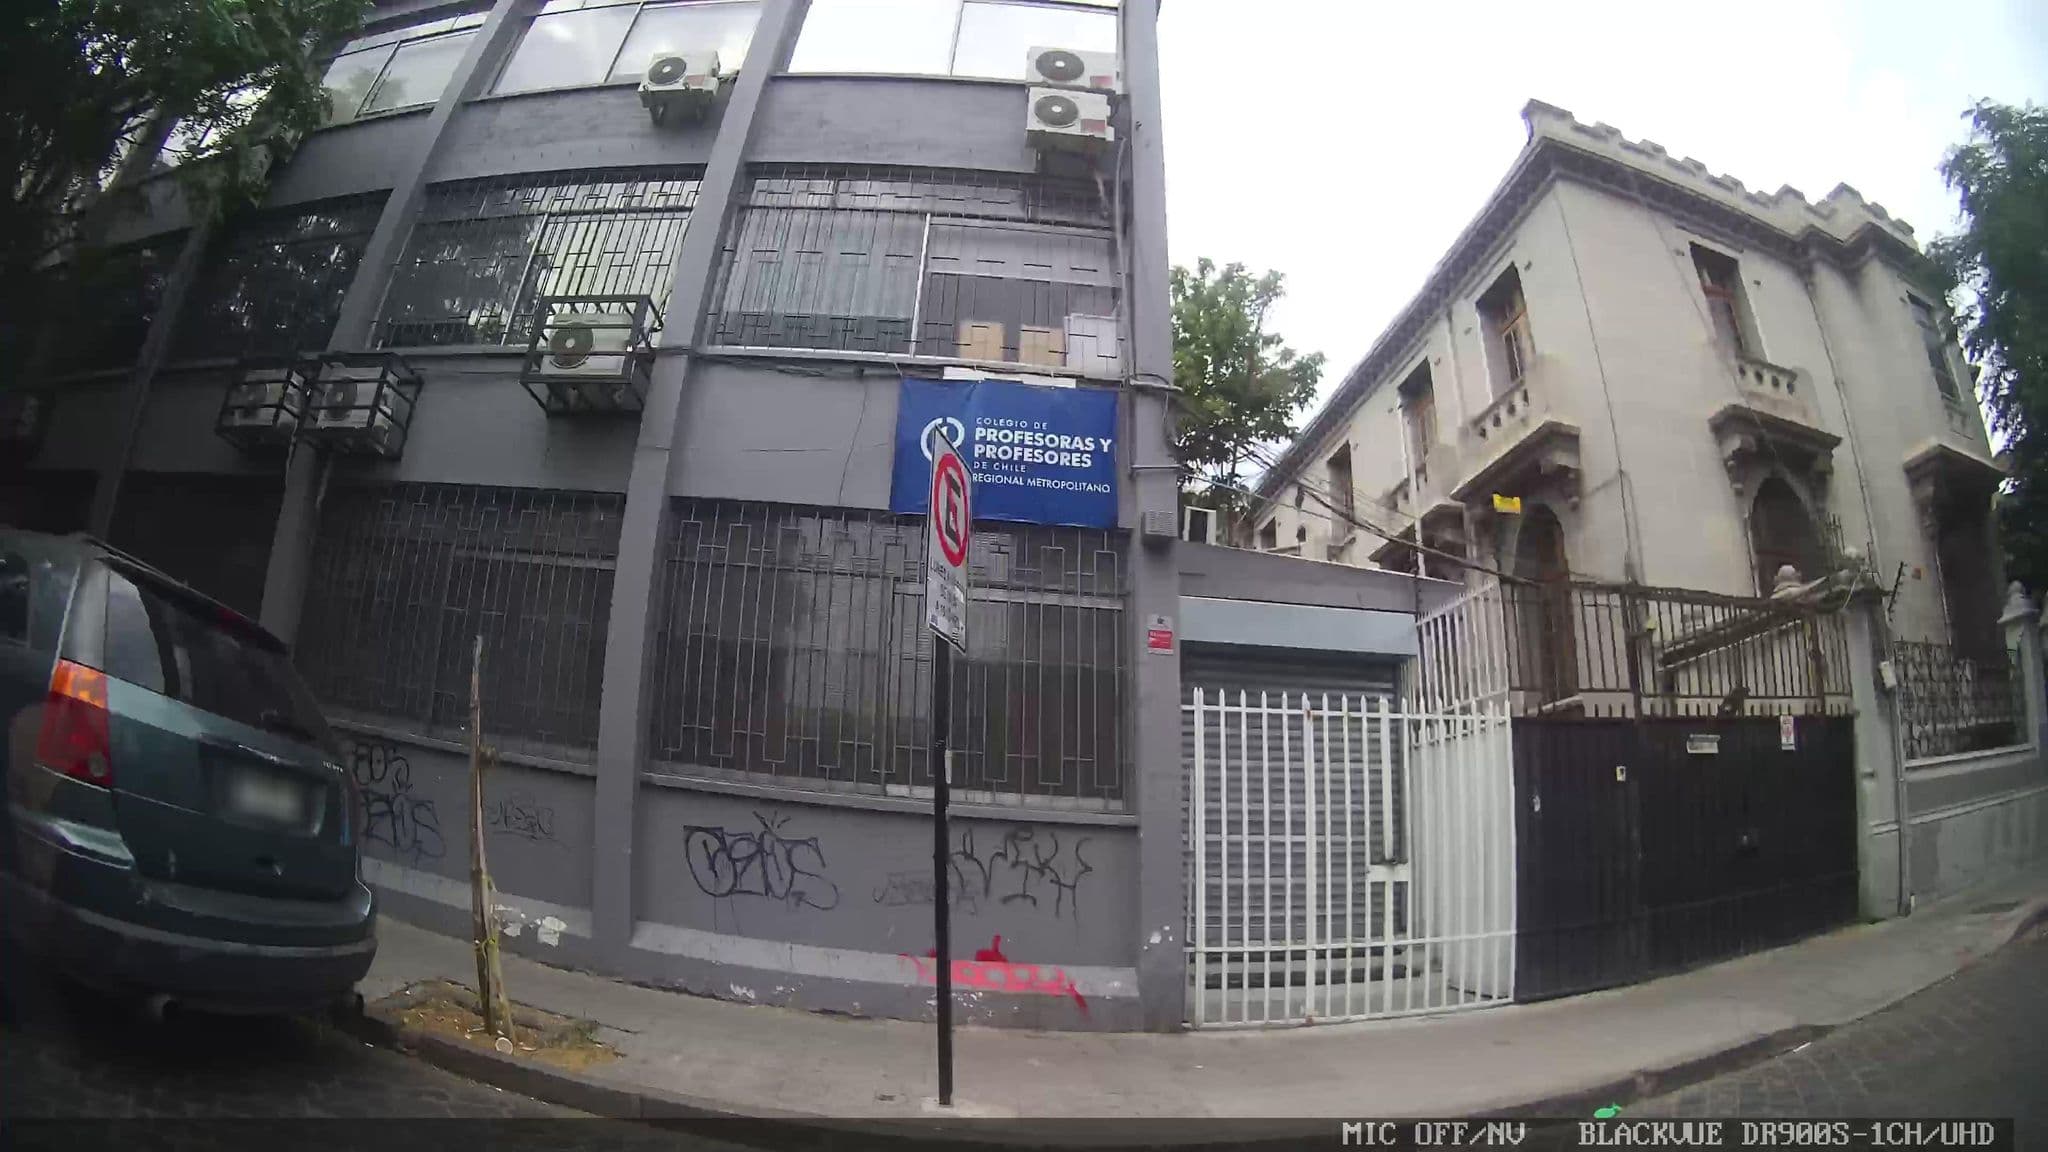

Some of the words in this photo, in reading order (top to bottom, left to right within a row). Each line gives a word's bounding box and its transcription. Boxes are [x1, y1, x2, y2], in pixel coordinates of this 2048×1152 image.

[976, 417, 1028, 428] COLEGIO
[1034, 422, 1048, 430] DE
[975, 427, 1095, 451] PROFESORAS
[1100, 438, 1112, 452] Y
[974, 444, 1092, 467] PROFESORES
[973, 461, 988, 469] DE
[993, 462, 1026, 473] CHILE
[972, 473, 1024, 485] REGIONAL
[1026, 478, 1110, 493] METROPOLITANO
